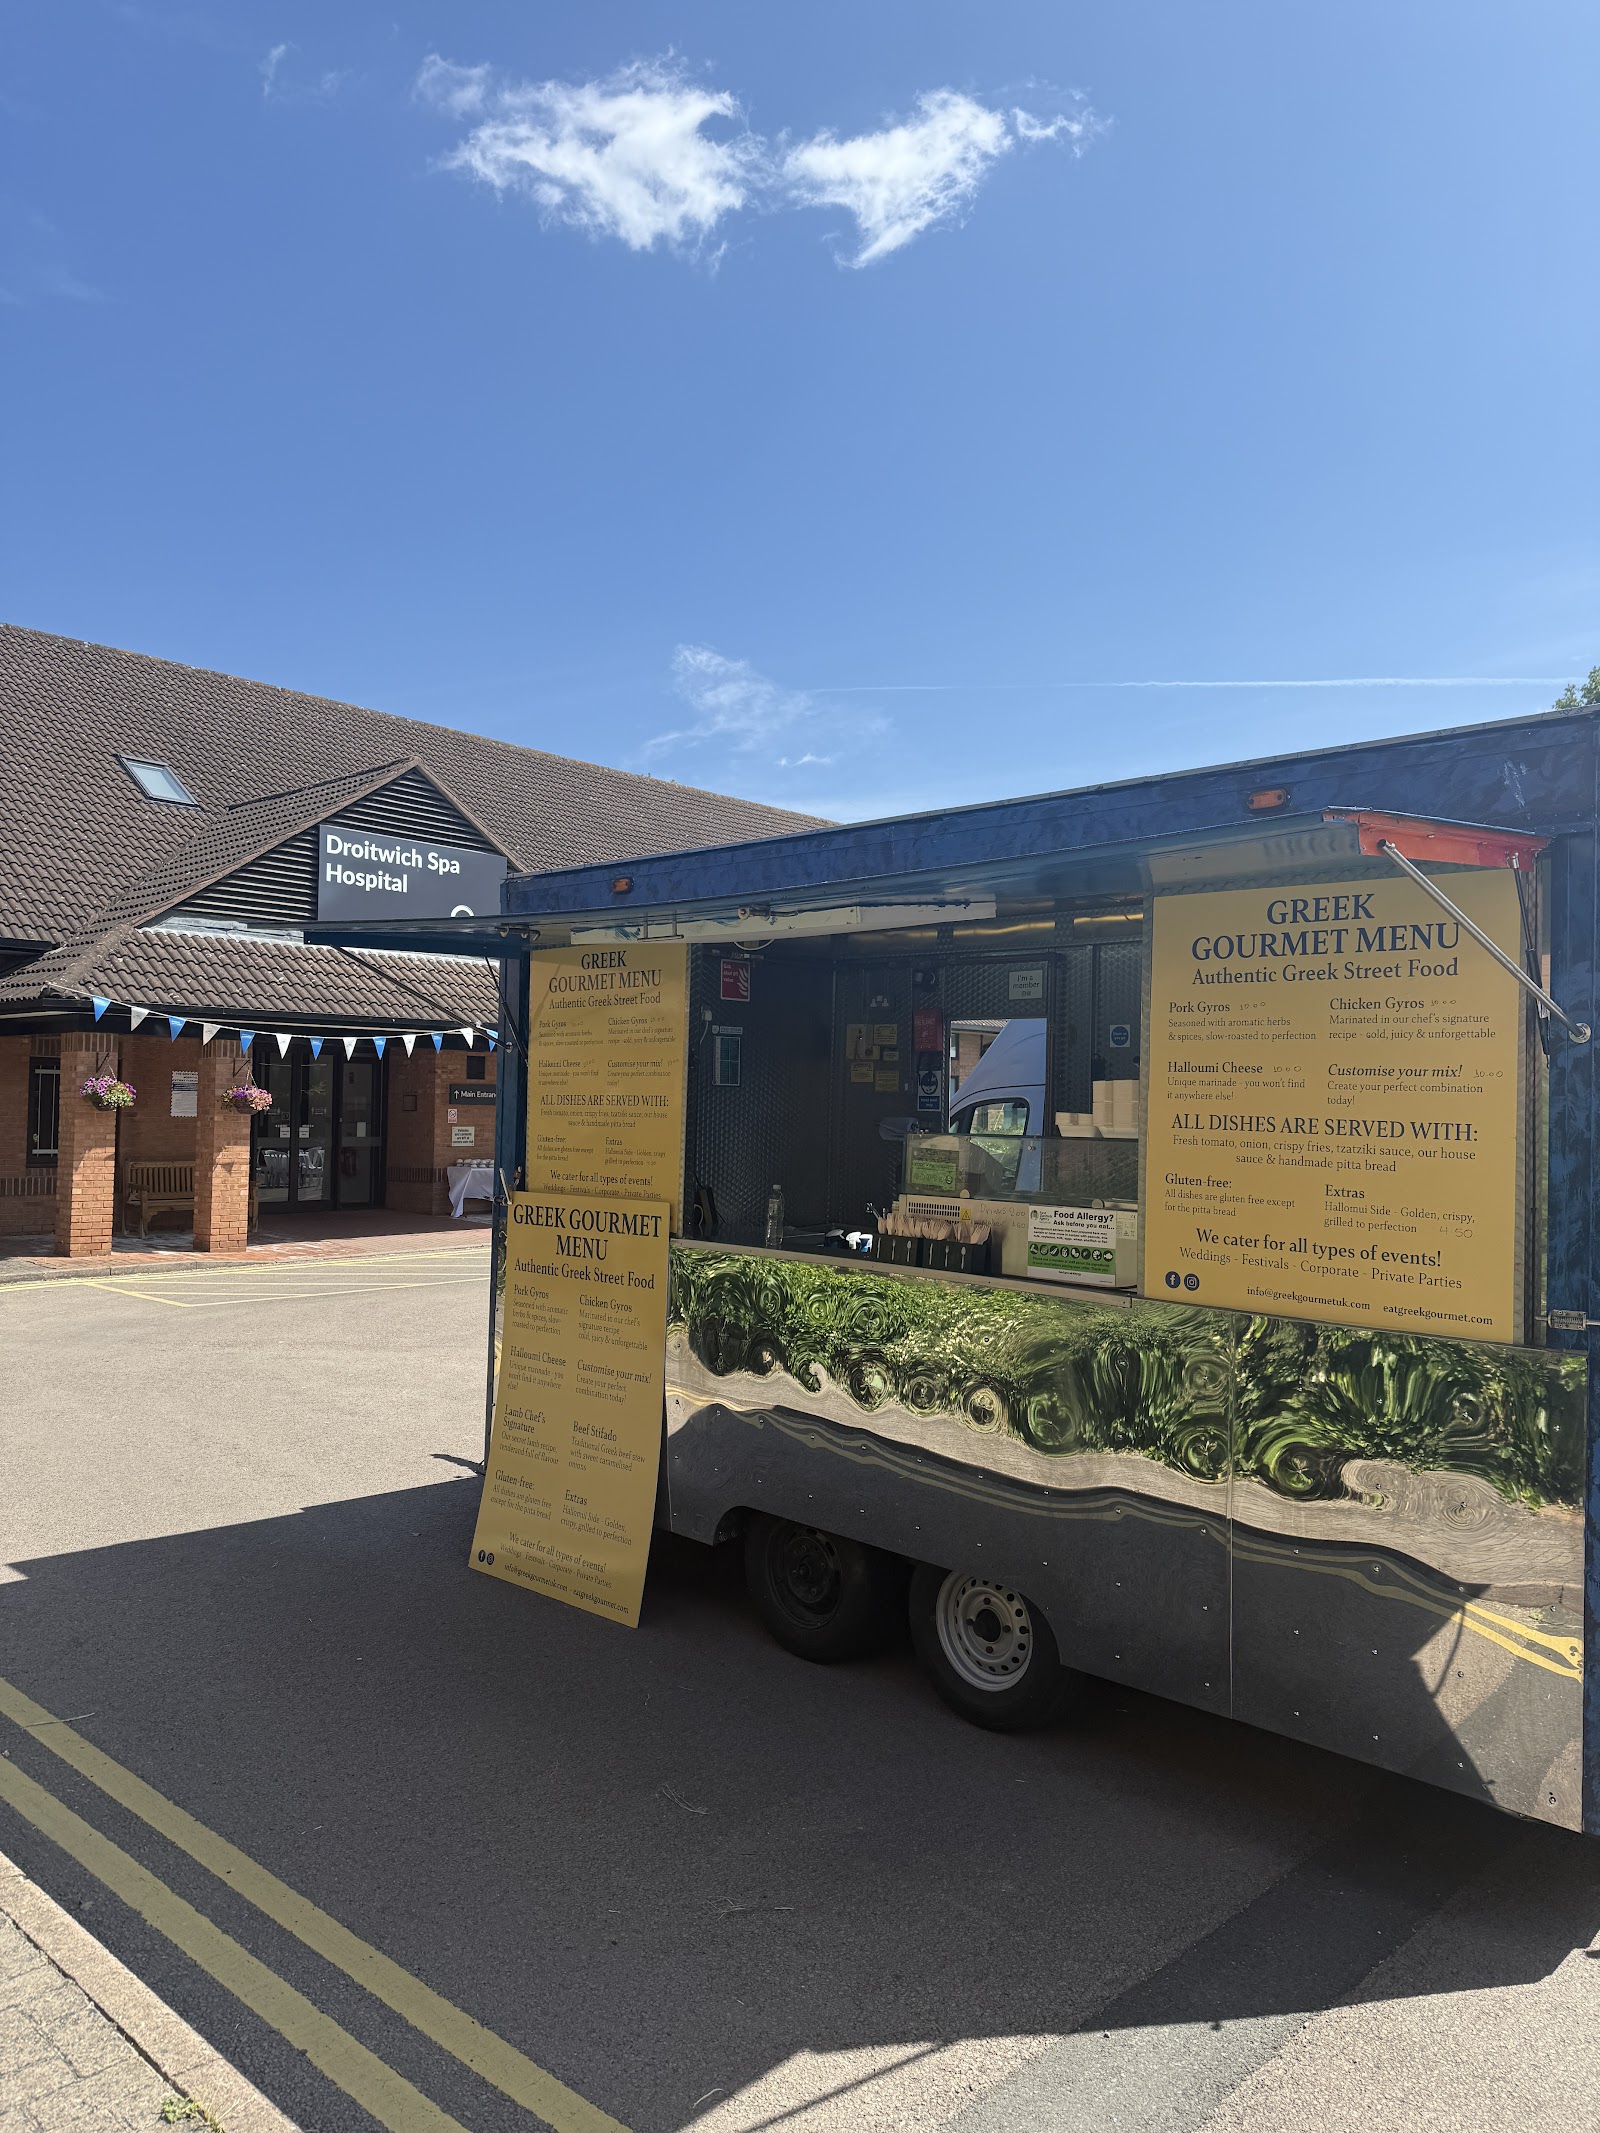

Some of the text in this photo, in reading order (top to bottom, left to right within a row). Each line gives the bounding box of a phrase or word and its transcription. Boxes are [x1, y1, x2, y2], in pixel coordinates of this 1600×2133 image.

[326, 834, 460, 875] Droitwich Spa
[326, 863, 408, 893] Hospital
[1266, 892, 1375, 925] GREEK
[1191, 919, 1462, 961] GOURMET MENU
[580, 950, 627, 970] GREEK
[1191, 956, 1459, 985] Authentic Greek Street Food
[548, 968, 662, 994] GOURMET MENU
[1012, 981, 1040, 989] member
[548, 990, 661, 1010] Authentic Greek Street Food
[1169, 1000, 1231, 1016] Pork Gyros
[1329, 996, 1425, 1013] Chicken Gyros
[1168, 1016, 1291, 1028] Seasoned with aromatic herbs
[1329, 1012, 1490, 1026] Marinated in our chef's signature
[1167, 1029, 1316, 1043] & spices, slow-roasted to perfection
[1328, 1027, 1496, 1042] recipe juicy & unforgettable
[1167, 1061, 1263, 1074] Halloumi Cheese
[1328, 1063, 1463, 1081] Customise your mix!
[1167, 1076, 1305, 1090] Unique marinade you won't find
[1326, 1080, 1483, 1094] Create your perfect combination
[539, 1093, 669, 1107] ALL DISHES ARE SERVED WITH:
[1167, 1089, 1234, 1102] it anywhere else!
[1326, 1094, 1355, 1108] today!
[1170, 1113, 1478, 1142] ALL DISHES ARE SERVED WITH:
[1172, 1133, 1476, 1160] Fresh tomato, onion, crispy fries, tzatziki sauce, our house
[1235, 1153, 1396, 1172] sauce & handmade pitta bread
[1164, 1172, 1232, 1189] Gluten-free:
[1164, 1187, 1295, 1210] All dishes are gluten free except
[1325, 1183, 1365, 1199] Extras
[1054, 1210, 1074, 1219] Food
[1077, 1211, 1114, 1224] Allergy?
[1164, 1201, 1236, 1217] for the pitta bread
[1370, 1204, 1391, 1216] Side
[1400, 1206, 1440, 1221] Golden,
[1442, 1211, 1475, 1225] crispy,
[513, 1203, 662, 1238] GREEK GOURMET
[1066, 1220, 1085, 1228] before
[1323, 1216, 1417, 1233] grilled to perfection
[555, 1234, 609, 1261] MENU
[1195, 1227, 1441, 1267] We cater for all types of events!
[513, 1257, 655, 1290] Authentic Greek Street Food
[1179, 1246, 1462, 1289] Weddings Festivals Corporate Private Parties
[513, 1283, 549, 1300] Pork Gyros
[579, 1294, 633, 1313] Chicken Gyros
[1246, 1286, 1493, 1325] info@greekgourmetuk.com eatgreekgourmet.com
[509, 1345, 567, 1367] Halloumi Cheese
[576, 1358, 652, 1384] Customise your mix!
[503, 1403, 546, 1424] Lamb Chef's
[502, 1415, 535, 1434] Signature
[572, 1420, 617, 1442] Beef Stifado
[495, 1469, 535, 1491] Gluten-free:
[564, 1489, 588, 1506] Extras
